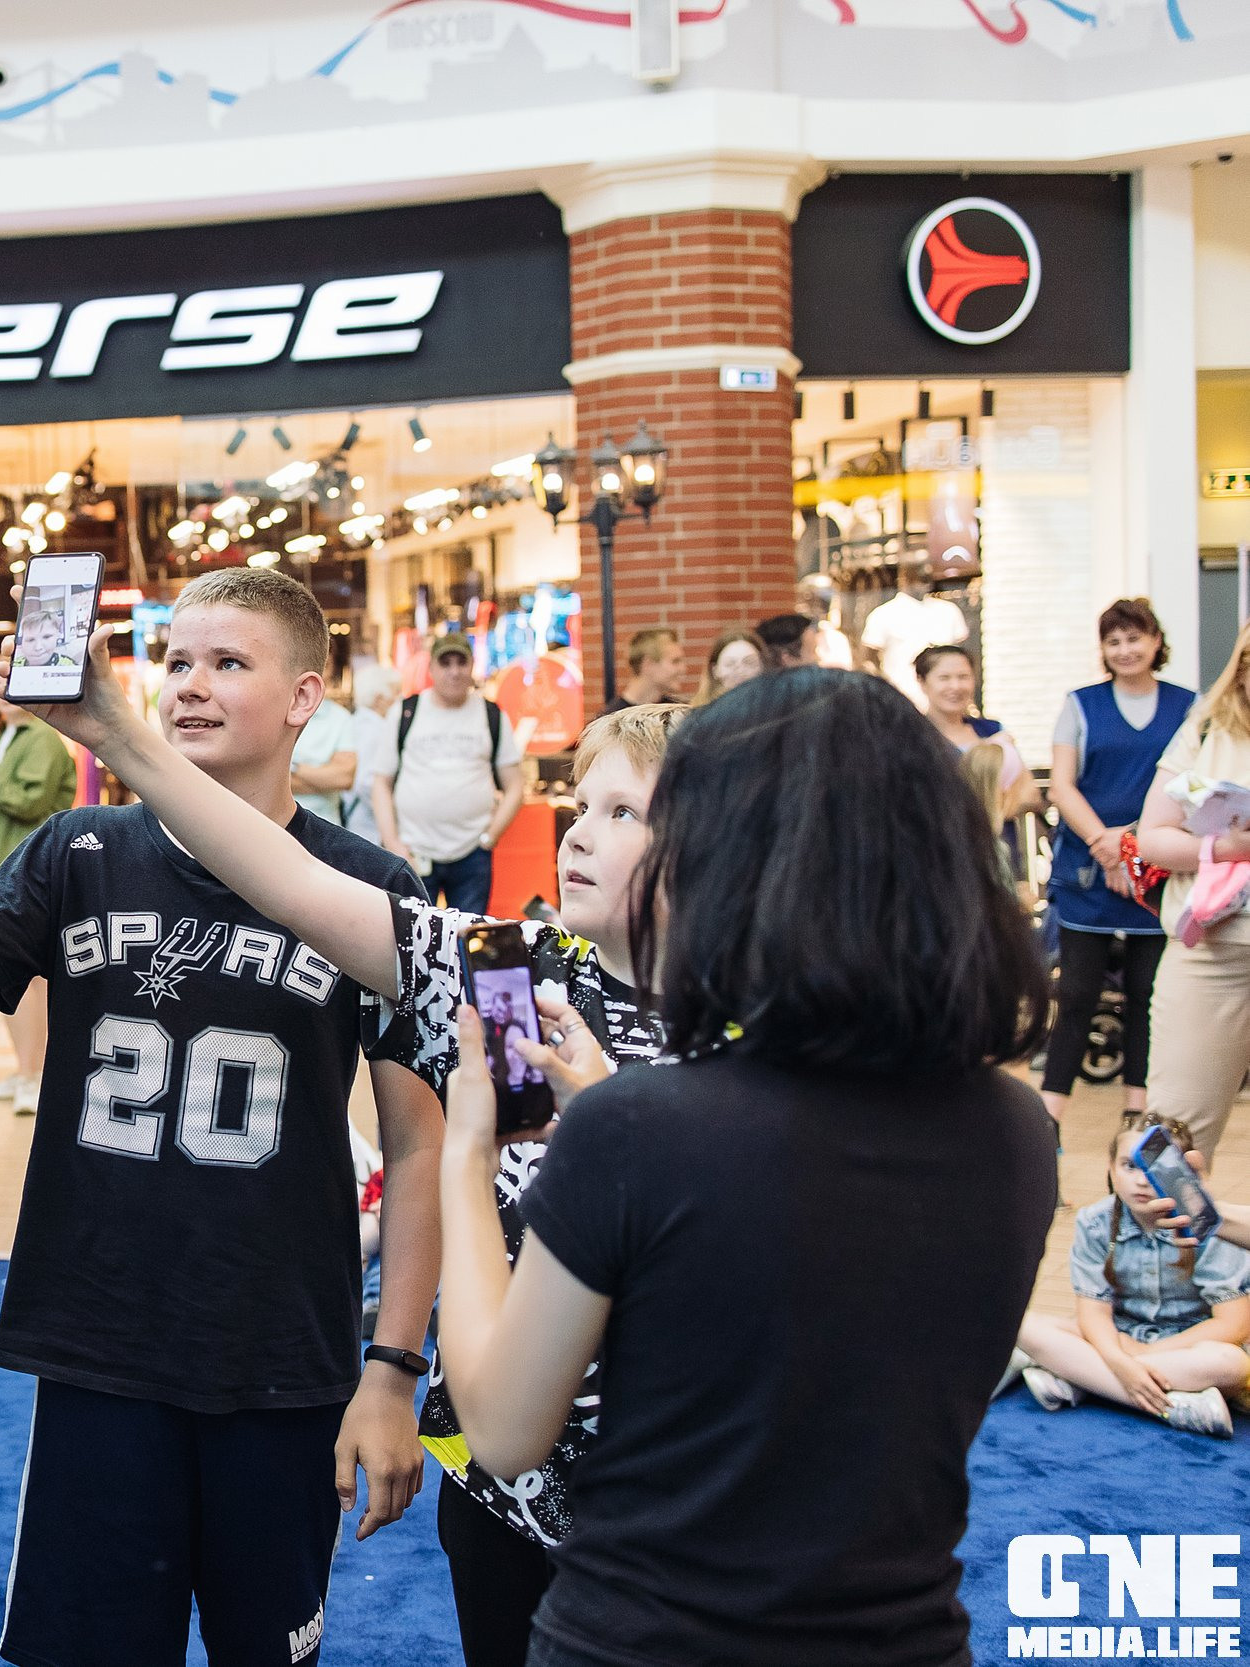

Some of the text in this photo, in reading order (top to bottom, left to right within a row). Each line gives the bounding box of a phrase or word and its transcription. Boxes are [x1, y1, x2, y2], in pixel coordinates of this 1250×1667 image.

[70, 840, 104, 851] adidas
[61, 911, 342, 1008] SPURS
[77, 1013, 291, 1169] 20
